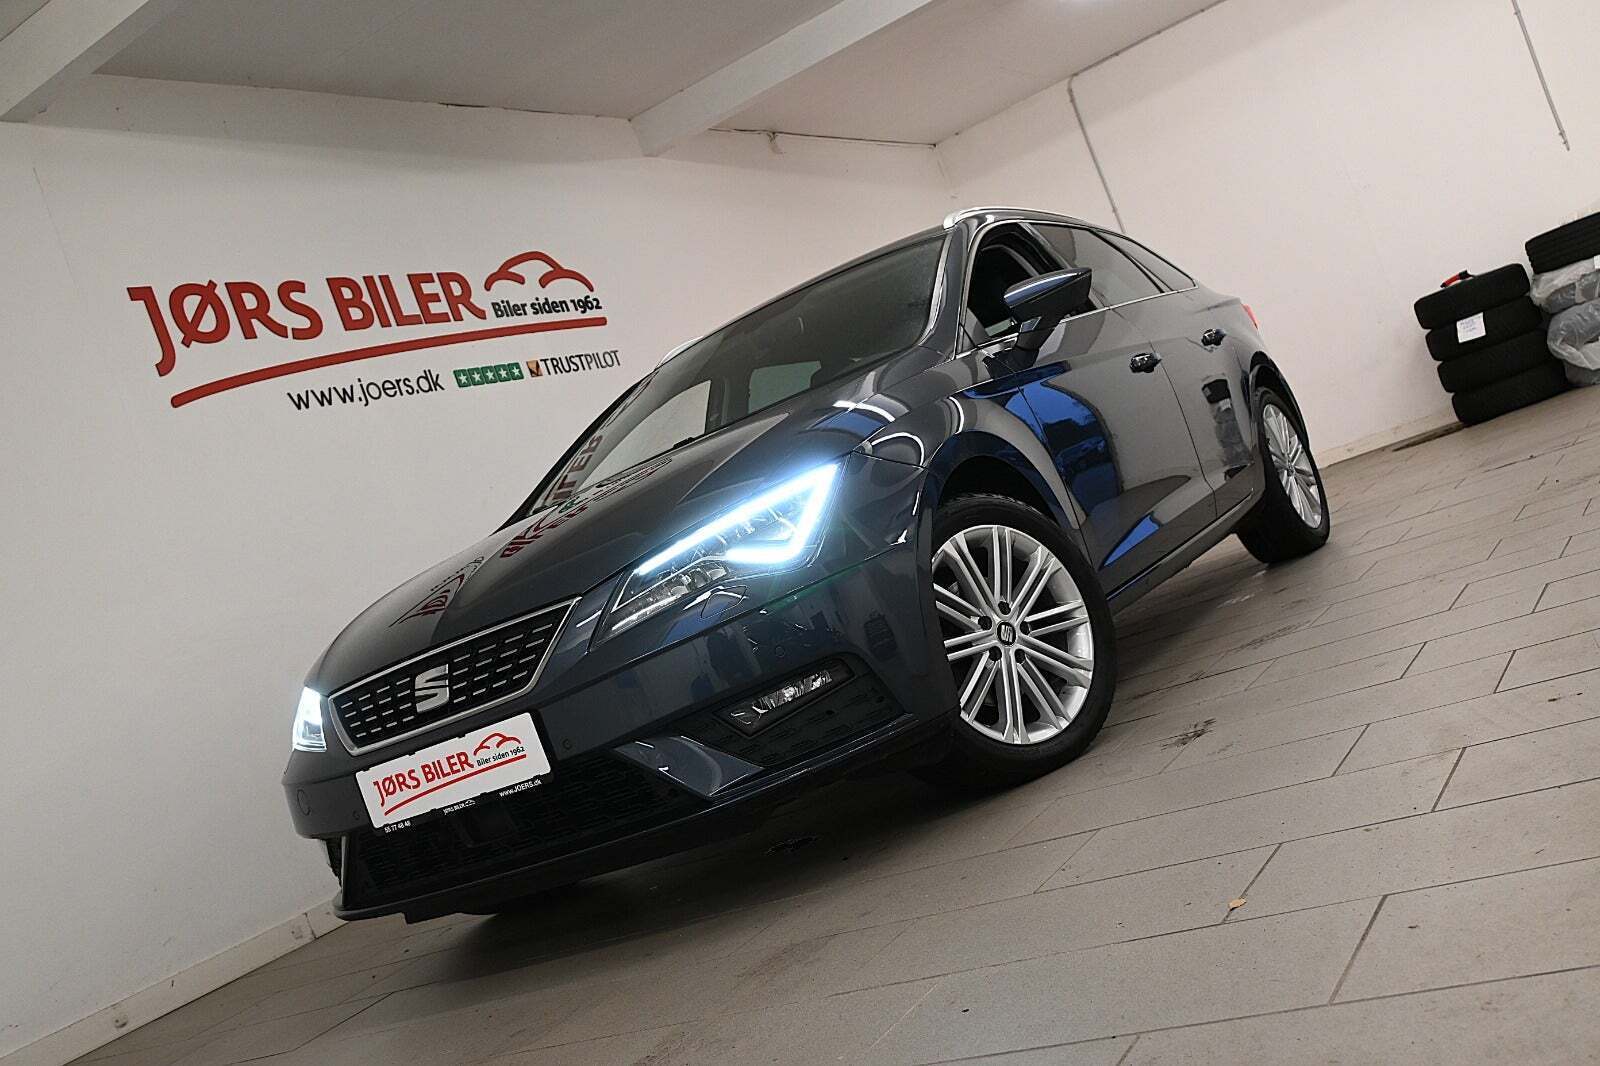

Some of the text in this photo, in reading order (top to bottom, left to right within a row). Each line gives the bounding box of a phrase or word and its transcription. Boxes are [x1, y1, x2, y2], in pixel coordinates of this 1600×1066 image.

[127, 271, 487, 377] JØRS BILER
[491, 296, 603, 319] Biler siden 1962
[539, 350, 622, 376] TRUSTPILOT
[287, 368, 445, 411] www.joers.dk
[476, 746, 525, 767] Biler siden 1962
[373, 751, 474, 807] JØRS BILER
